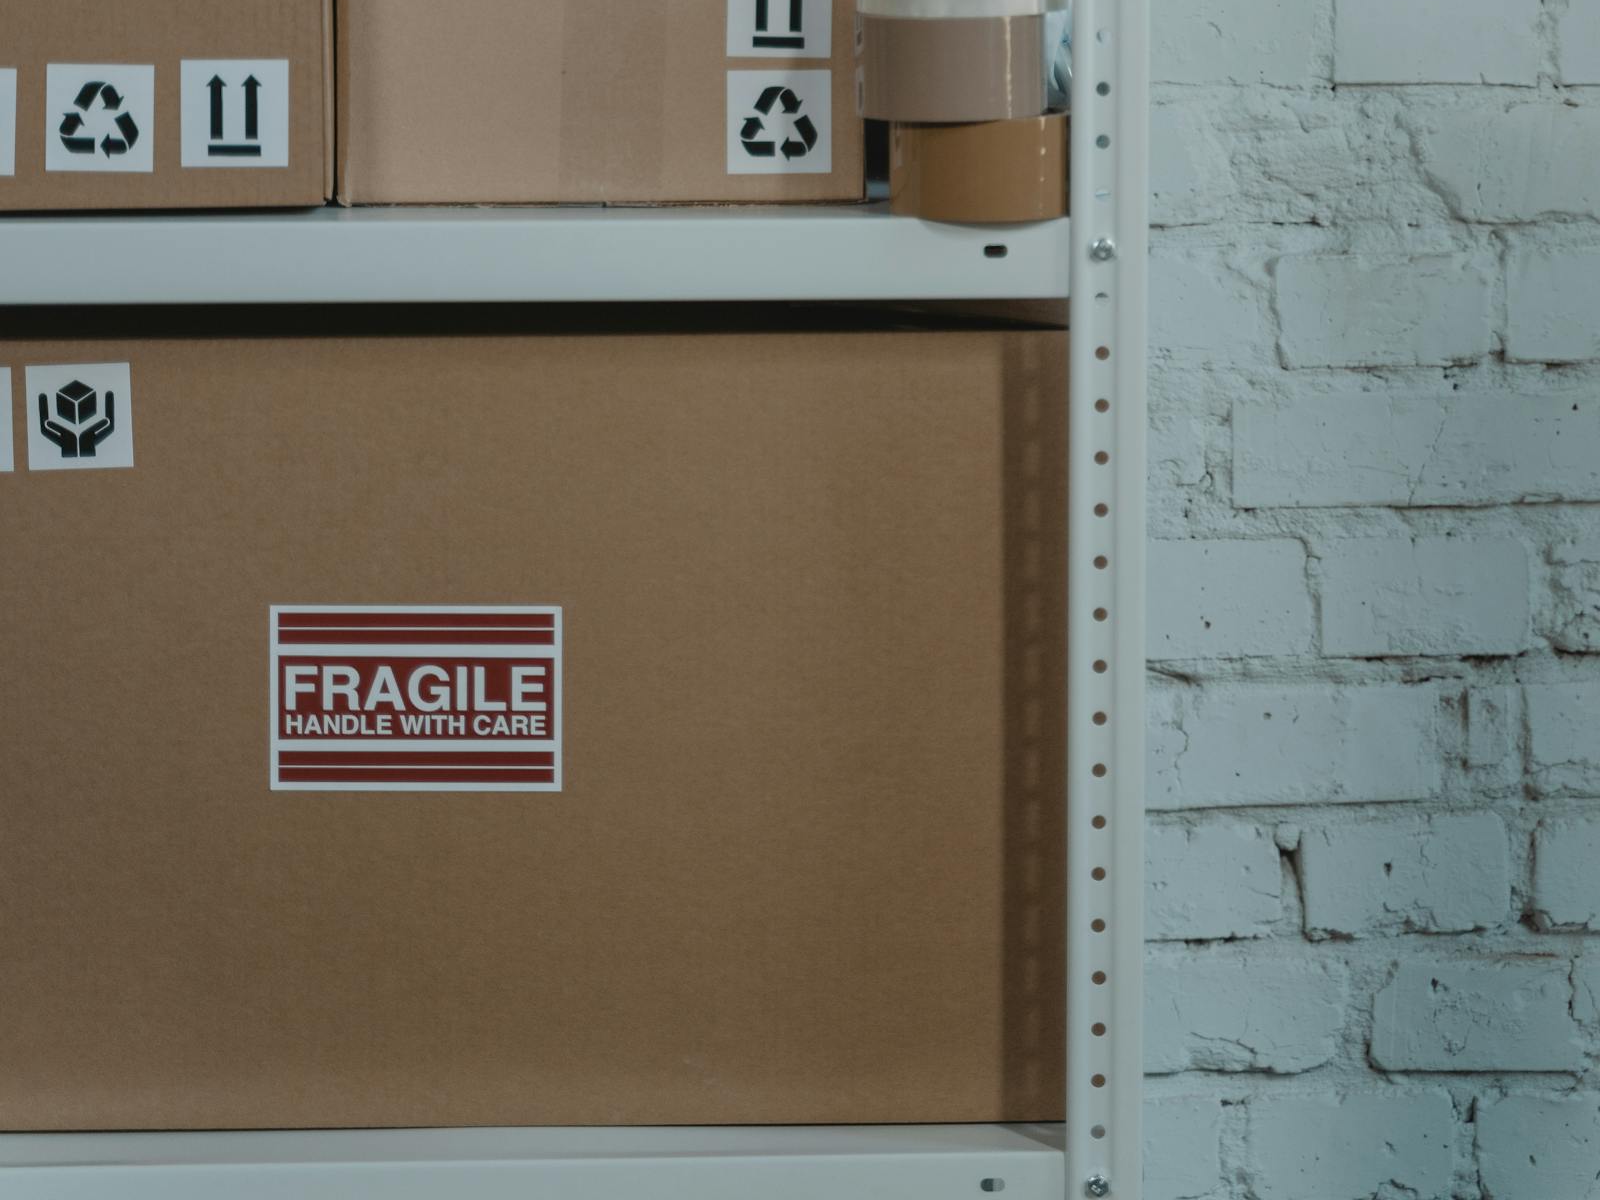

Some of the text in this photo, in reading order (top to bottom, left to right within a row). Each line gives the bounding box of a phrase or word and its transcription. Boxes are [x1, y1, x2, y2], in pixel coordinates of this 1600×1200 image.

[284, 665, 547, 712] FRAGILE
[285, 714, 547, 736] HANDLE WITH CARE
